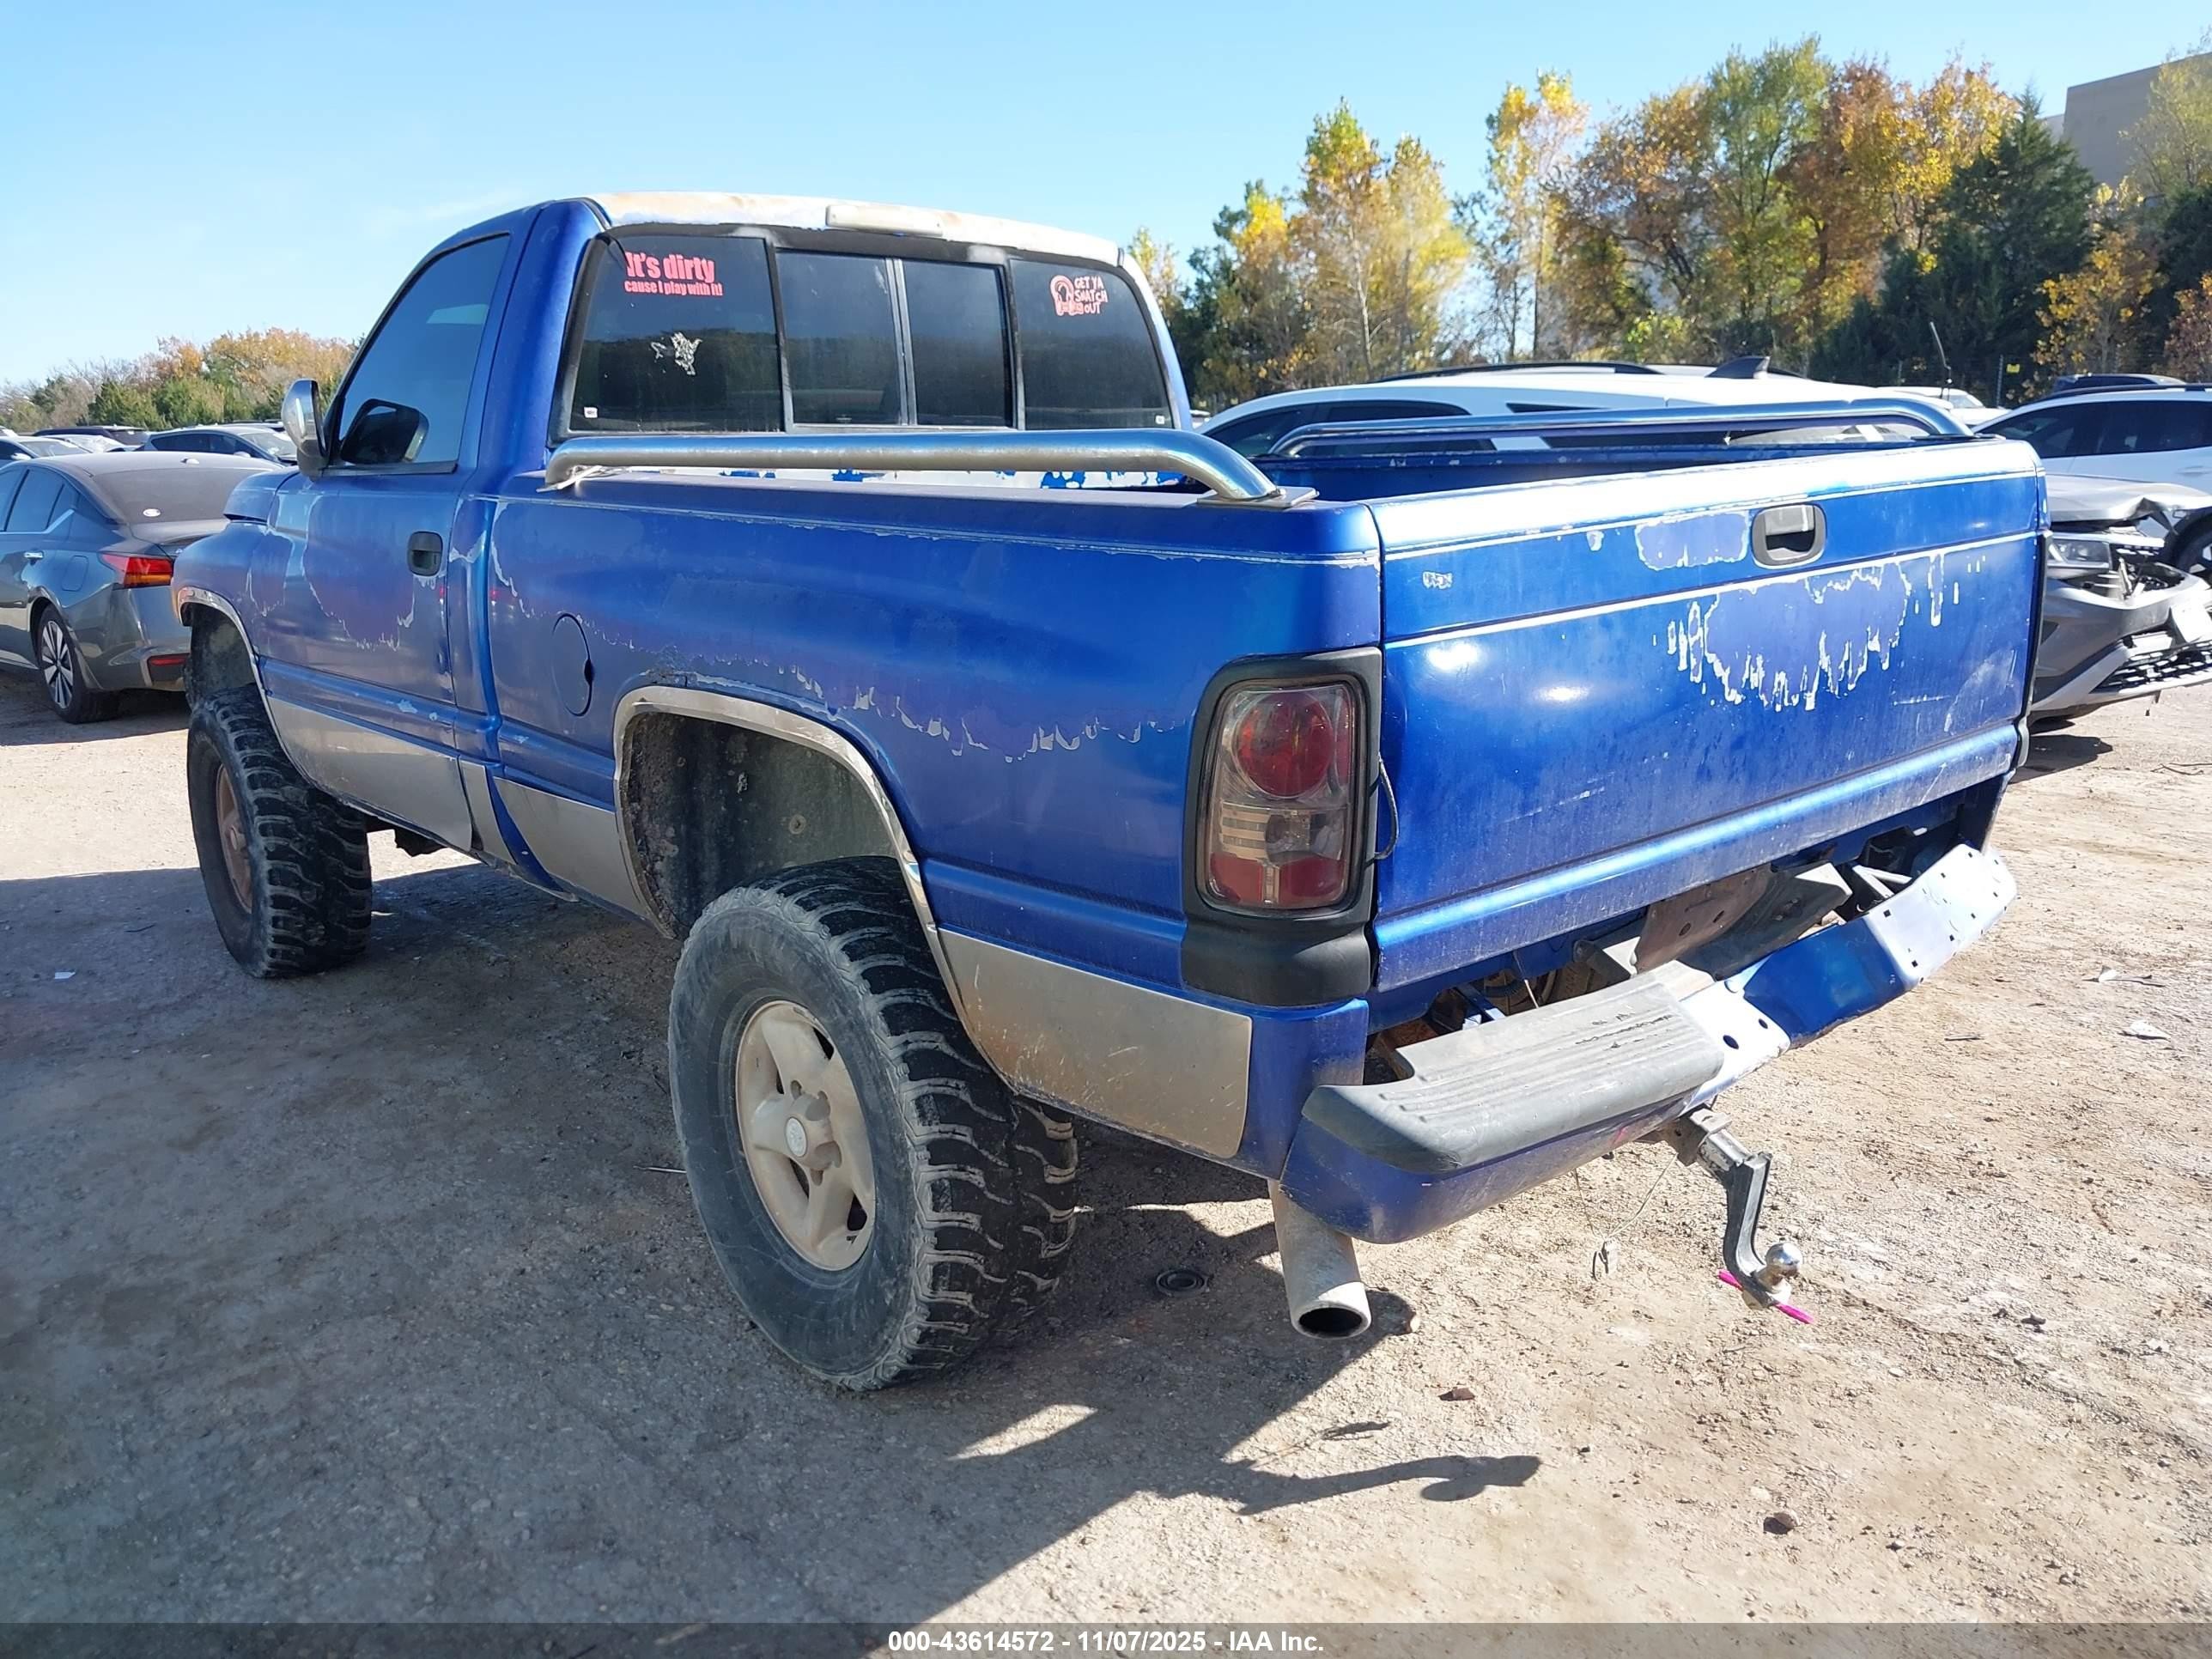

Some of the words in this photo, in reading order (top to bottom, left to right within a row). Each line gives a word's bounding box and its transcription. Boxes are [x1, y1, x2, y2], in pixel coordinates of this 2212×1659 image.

[625, 252, 660, 278] It's
[663, 254, 714, 283] dirty
[624, 281, 657, 293] cause
[658, 280, 664, 294] I
[664, 281, 687, 296] play
[687, 282, 710, 295] with
[1074, 276, 1090, 289] GET
[1091, 276, 1104, 289] YA
